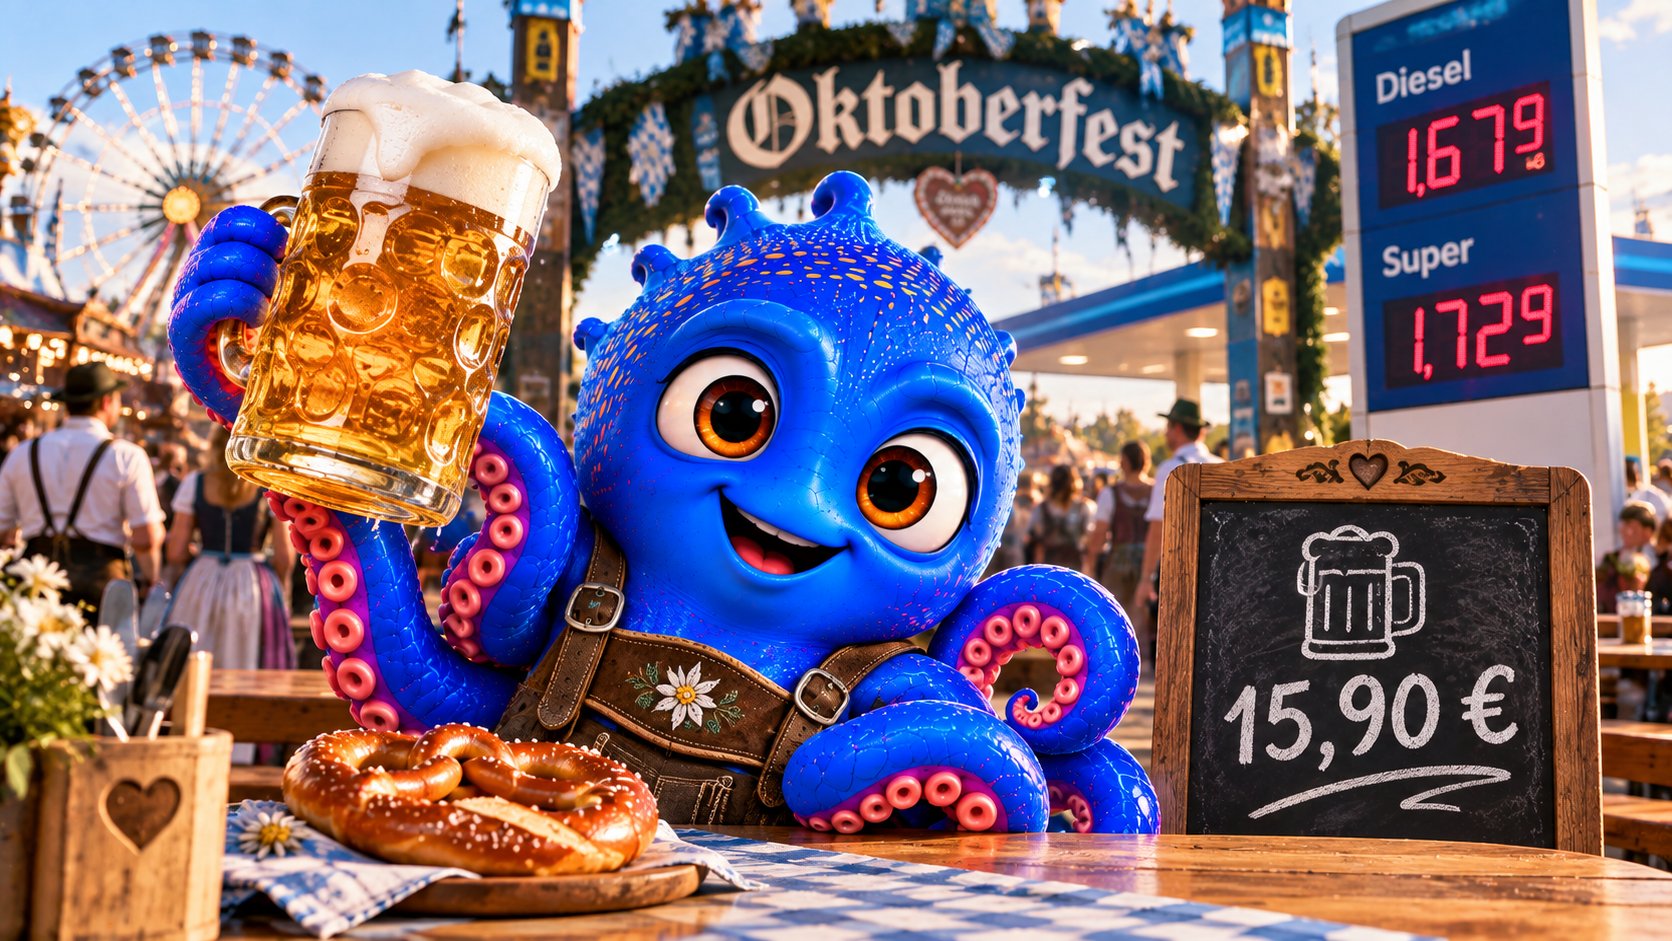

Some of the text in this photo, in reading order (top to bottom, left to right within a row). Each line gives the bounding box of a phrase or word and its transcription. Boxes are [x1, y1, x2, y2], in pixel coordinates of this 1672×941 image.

[727, 61, 1185, 193] Oktoberfest
[1376, 49, 1471, 104] Diesel
[1406, 92, 1546, 198] 1,679
[1382, 238, 1474, 279] Super
[1412, 283, 1554, 381] 1,729
[1223, 663, 1519, 772] 15,90 €
